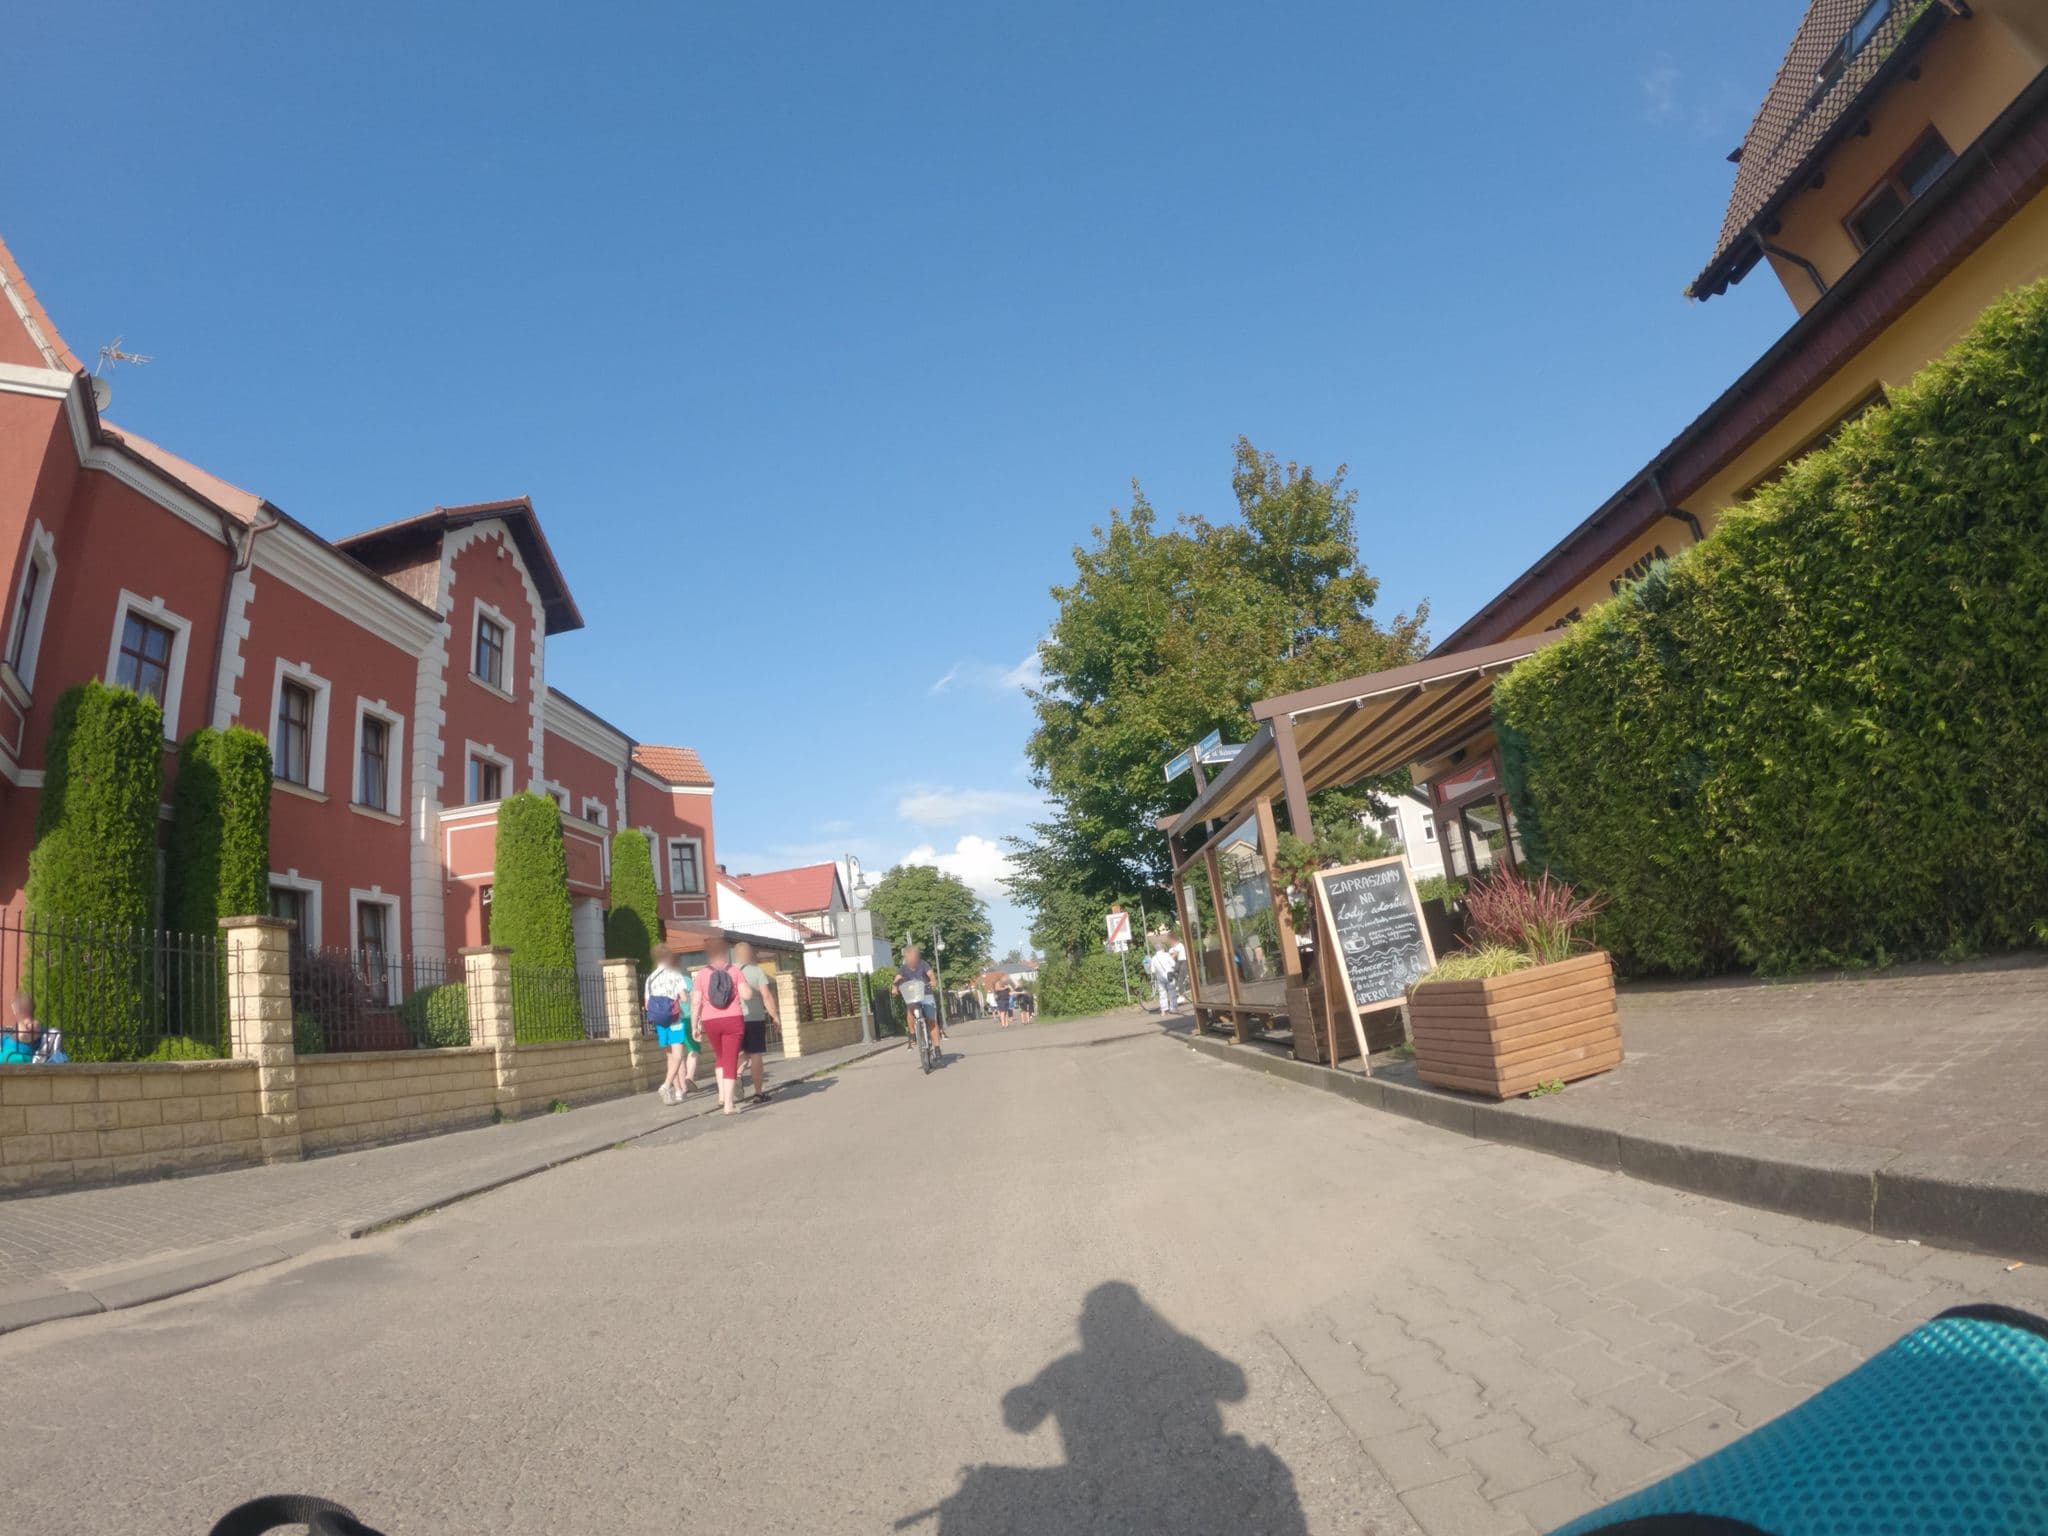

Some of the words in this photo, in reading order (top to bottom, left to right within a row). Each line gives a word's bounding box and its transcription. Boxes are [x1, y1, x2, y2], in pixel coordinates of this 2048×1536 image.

[1330, 870, 1399, 895] ZAPRASZAMY
[1359, 891, 1376, 904] NA
[1337, 903, 1367, 922] Lody
